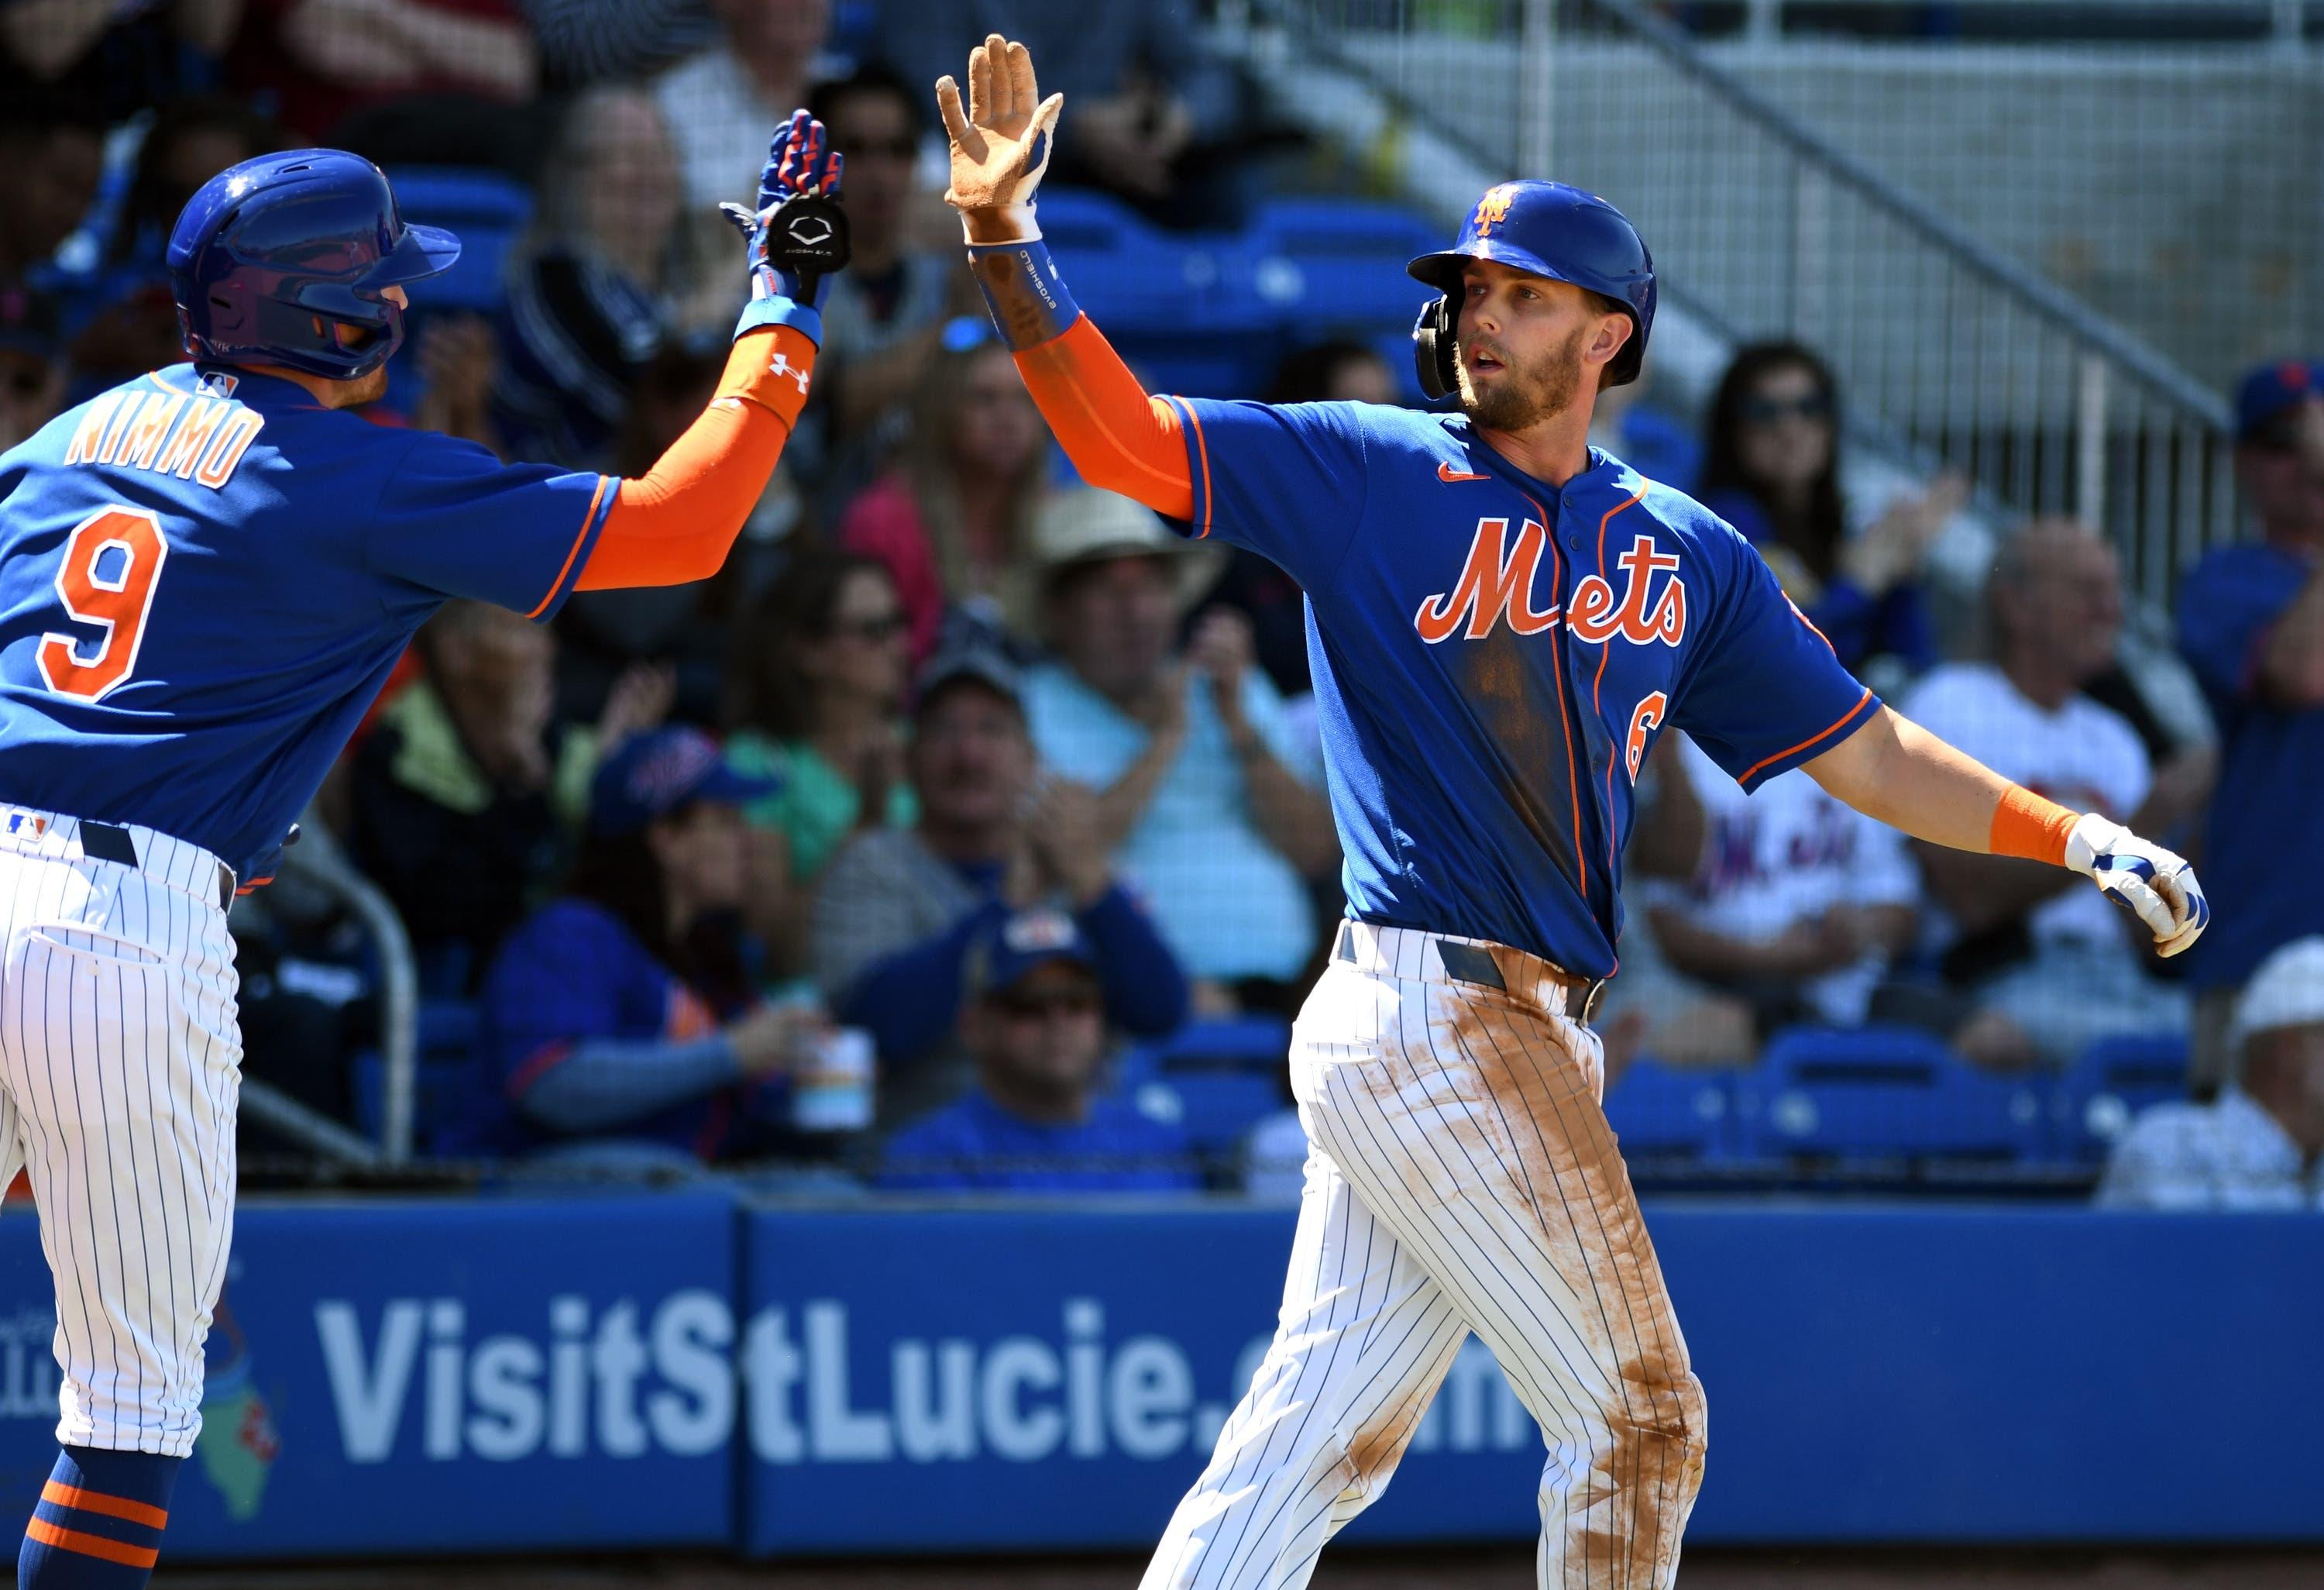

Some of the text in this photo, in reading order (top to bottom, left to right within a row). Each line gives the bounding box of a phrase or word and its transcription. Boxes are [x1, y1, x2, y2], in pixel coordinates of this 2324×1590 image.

[64, 390, 265, 489] NIMMO
[35, 504, 168, 704] 9
[1414, 517, 1686, 647] Mets
[1625, 690, 1667, 787] 6
